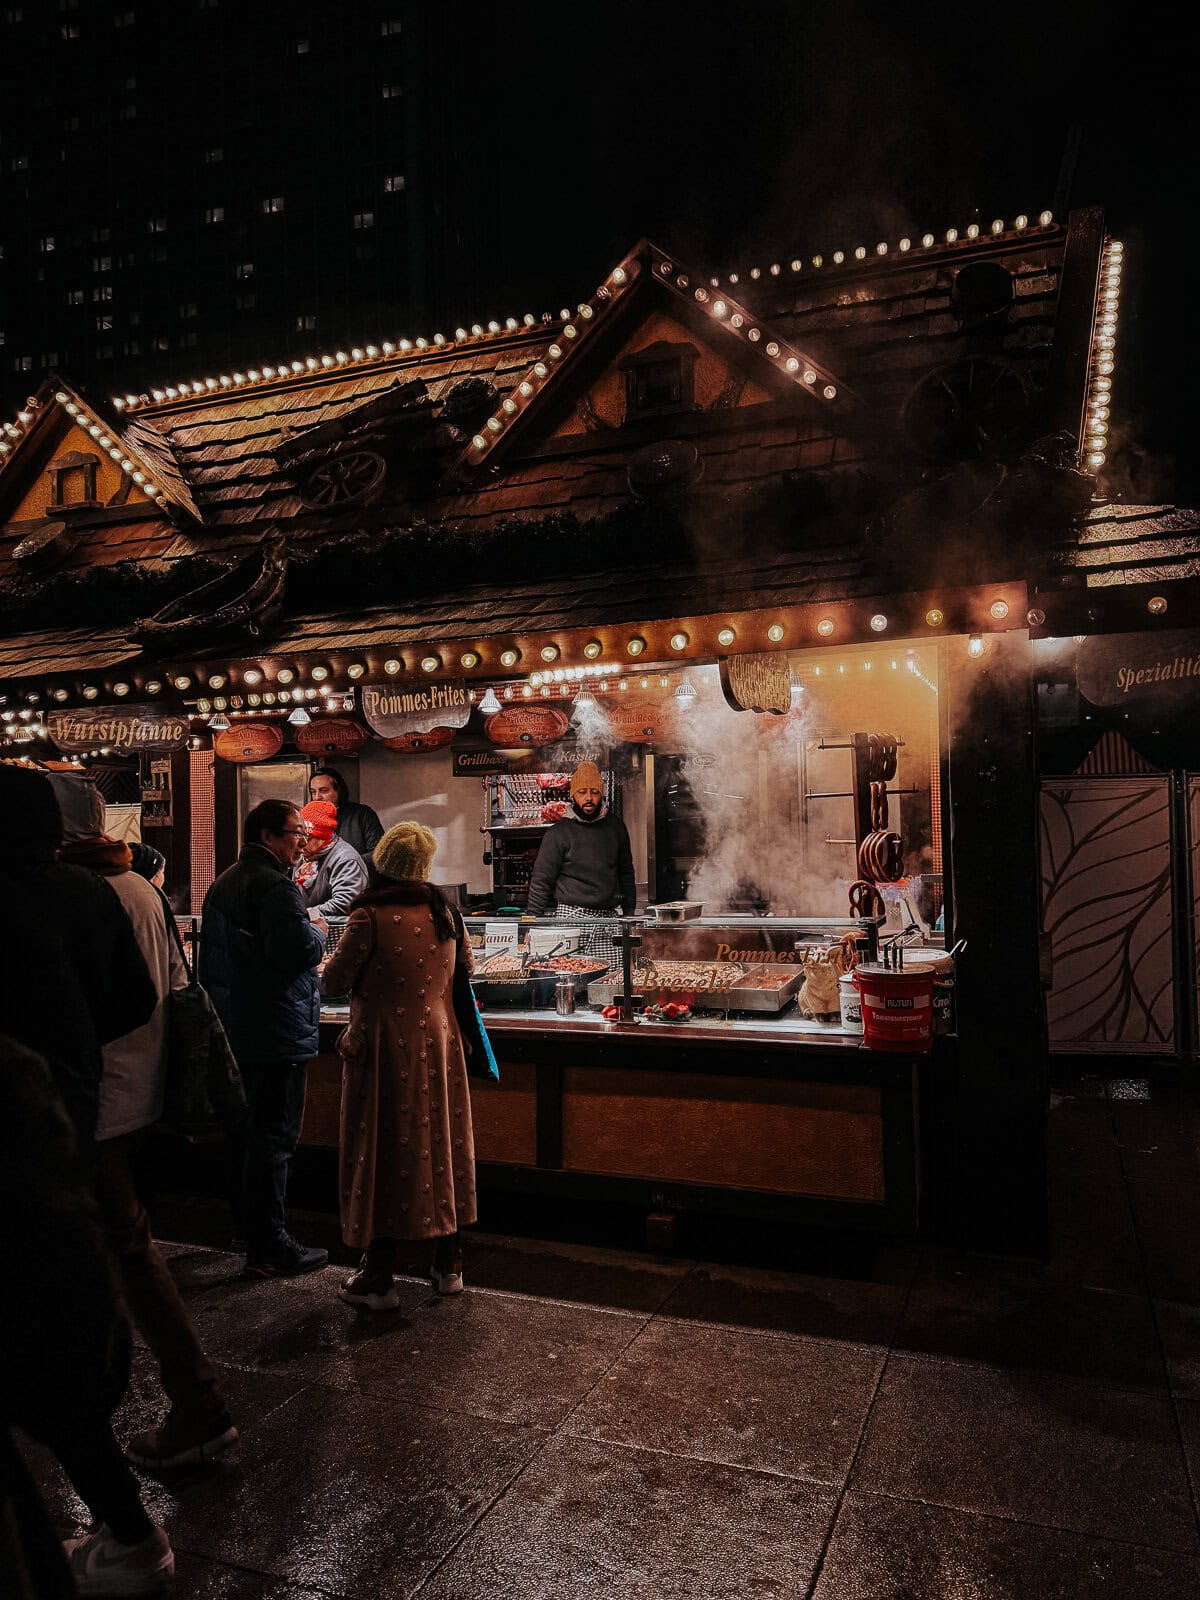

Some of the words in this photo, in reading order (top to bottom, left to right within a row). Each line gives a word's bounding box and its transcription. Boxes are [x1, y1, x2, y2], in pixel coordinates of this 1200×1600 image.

[369, 685, 465, 716] Pommes-Frites
[55, 718, 183, 747] Wurstpfanne
[560, 751, 600, 762] Kassler
[715, 943, 795, 963] Pommes
[640, 970, 733, 994] Brezeln
